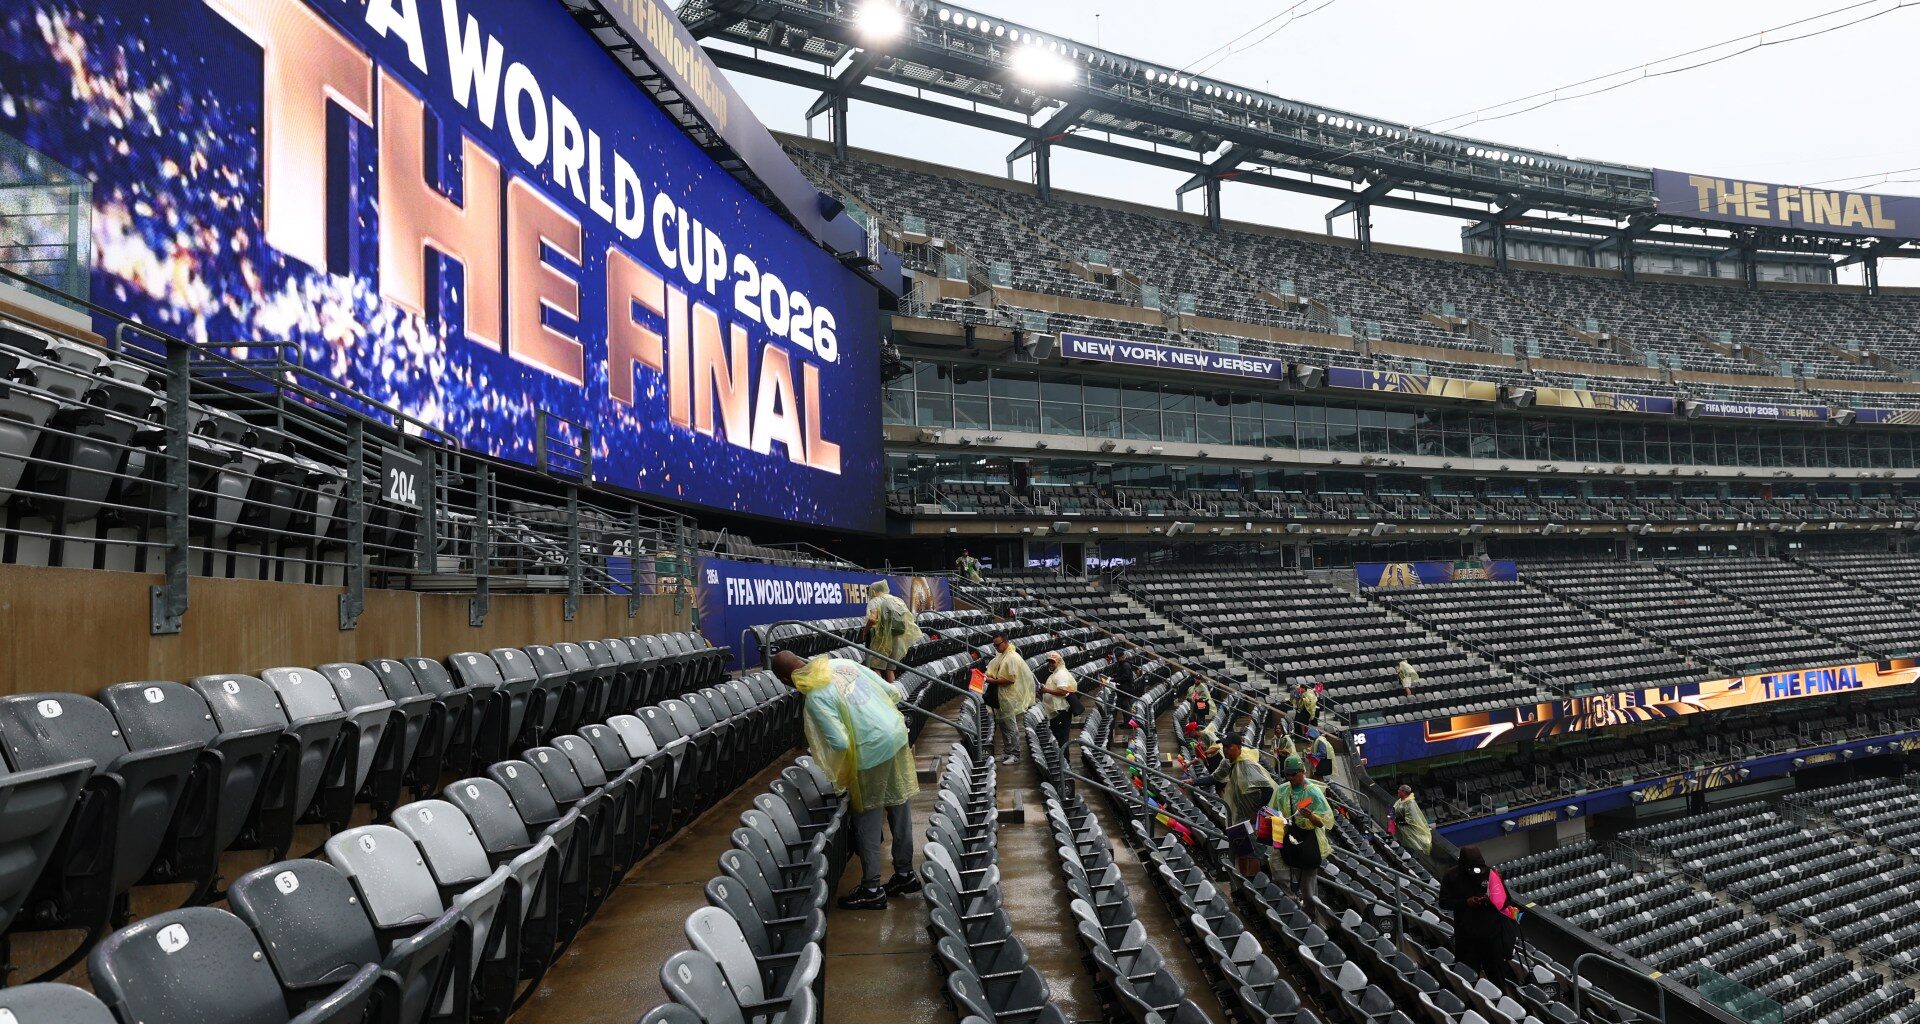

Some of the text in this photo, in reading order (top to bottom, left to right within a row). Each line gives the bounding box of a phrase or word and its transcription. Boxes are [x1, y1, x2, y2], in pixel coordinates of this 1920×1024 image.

[440, 0, 644, 239] WORLD
[652, 192, 728, 295] CUP
[734, 253, 838, 362] 2026
[1689, 175, 1896, 230] THE FINAL
[202, 0, 841, 475] THE FINAL
[1073, 340, 1273, 374] NEW YORK NEW JERSEY
[1705, 404, 1819, 417] FIFA WORLD CUP 2026 THE FINAL
[390, 468, 416, 505] 204
[725, 577, 754, 605] FIFA
[753, 579, 795, 605] WORLD
[795, 581, 813, 604] CUP
[813, 582, 841, 604] 2026
[842, 583, 860, 604] THE
[292, 674, 300, 682] 9
[340, 669, 350, 678] 10
[228, 683, 236, 691] 8
[1760, 666, 1863, 699] THE FINAL
[149, 691, 158, 700] 7
[46, 704, 54, 714] 6
[421, 811, 429, 821] 7
[365, 839, 372, 849] 6
[281, 876, 292, 889] 5
[168, 930, 180, 945] 4
